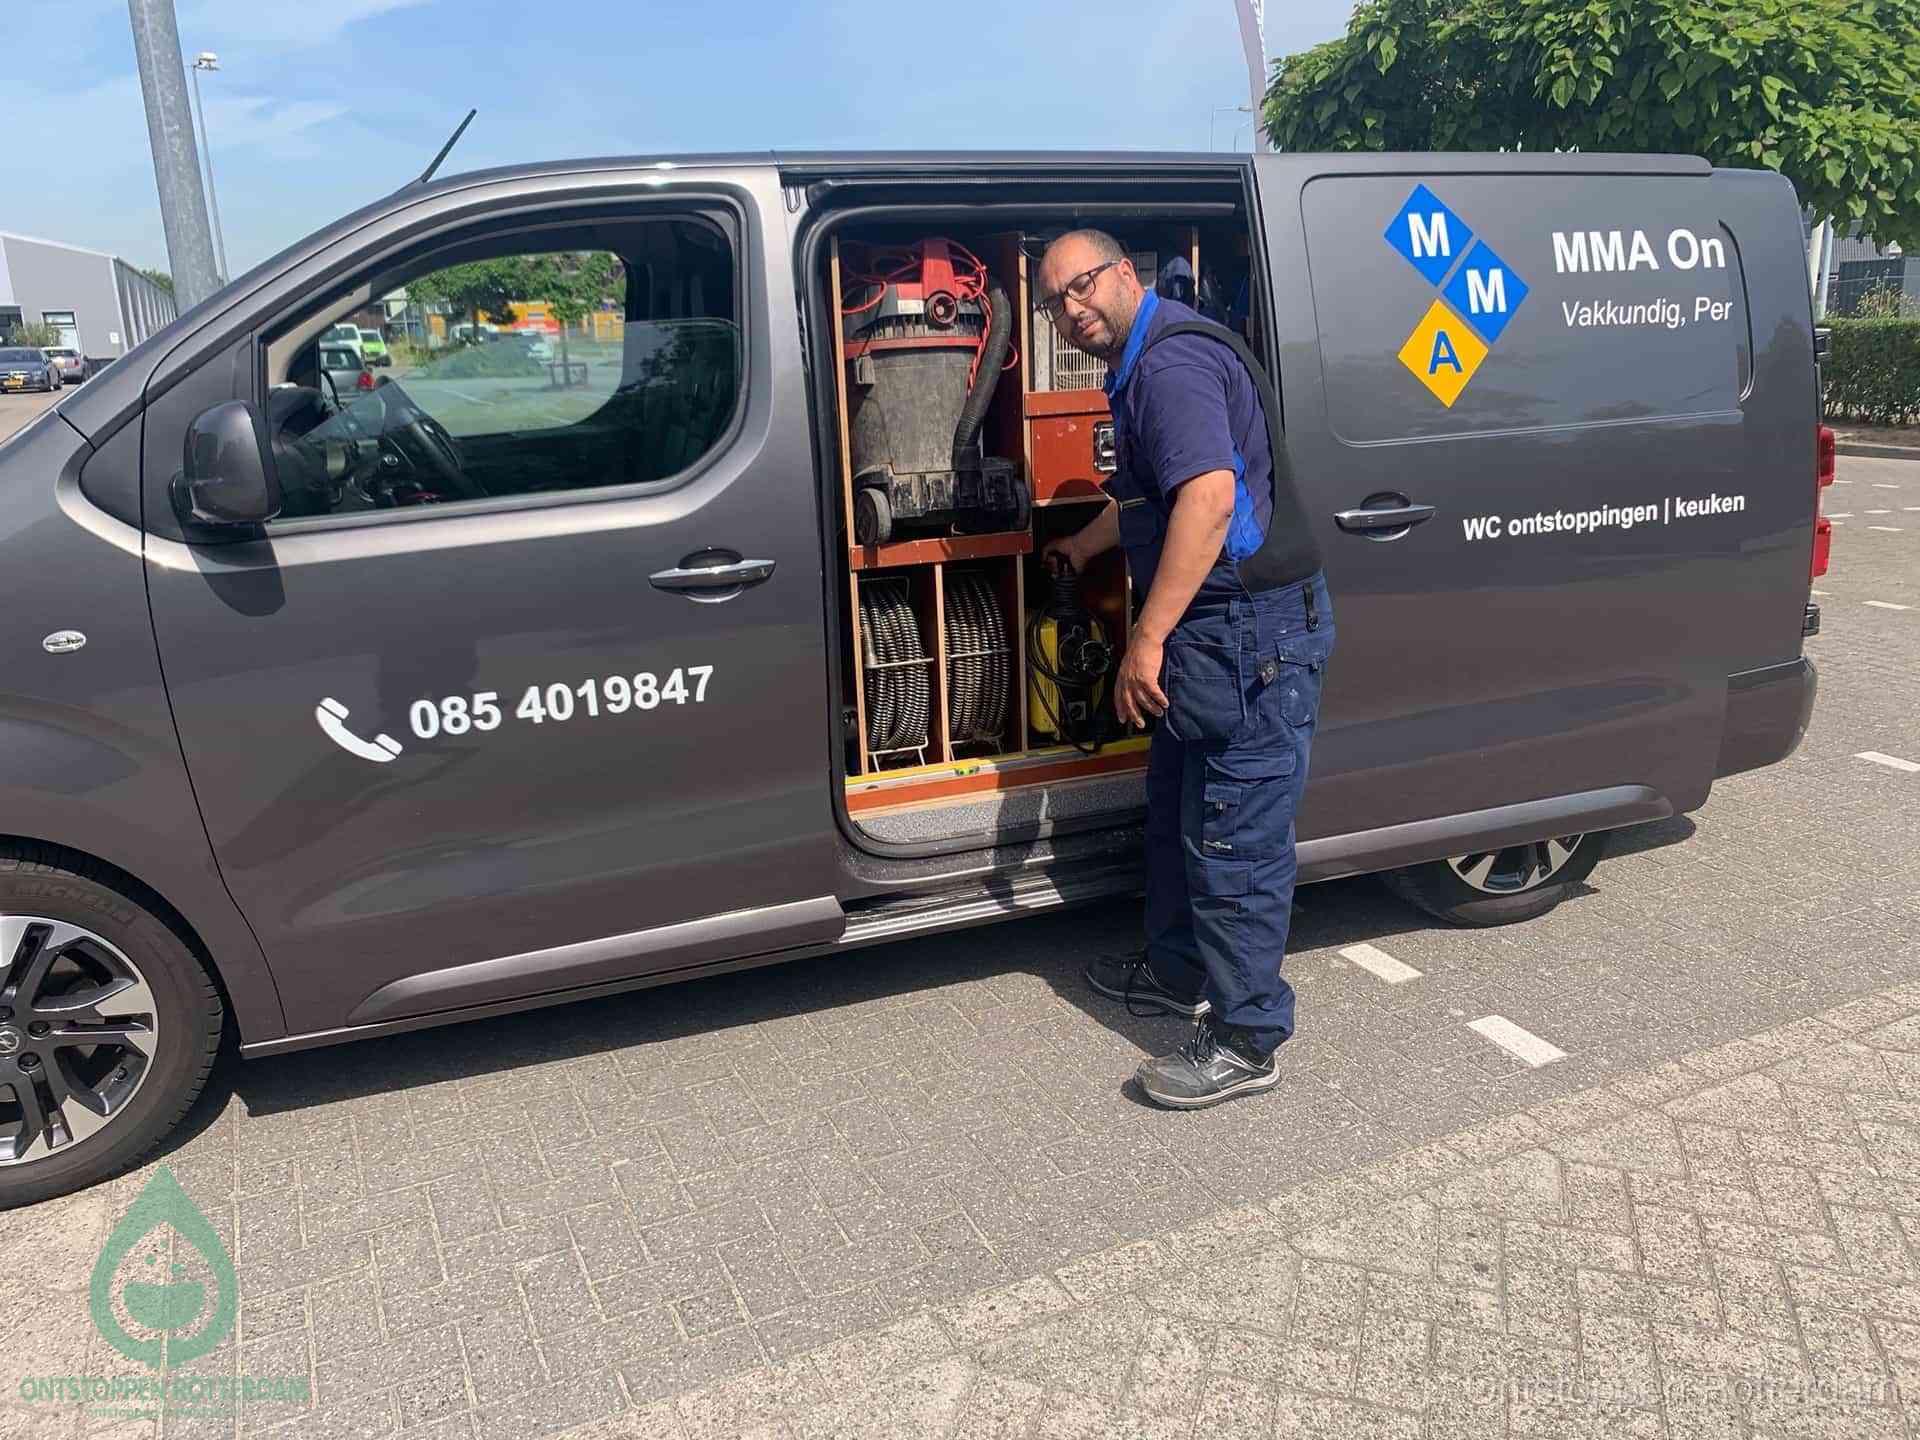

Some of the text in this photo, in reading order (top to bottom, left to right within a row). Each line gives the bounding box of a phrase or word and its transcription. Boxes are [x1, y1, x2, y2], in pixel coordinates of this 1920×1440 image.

[1406, 211, 1451, 258] M
[1550, 228, 1726, 274] MMA On
[1465, 268, 1507, 315] M
[1561, 296, 1733, 329] Vakkundig, Per
[1428, 330, 1463, 375] A
[1462, 515, 1502, 541] WC
[1508, 503, 1658, 535] ontstoppingen
[1674, 493, 1746, 518] keuken
[410, 665, 714, 739] 085 4019847
